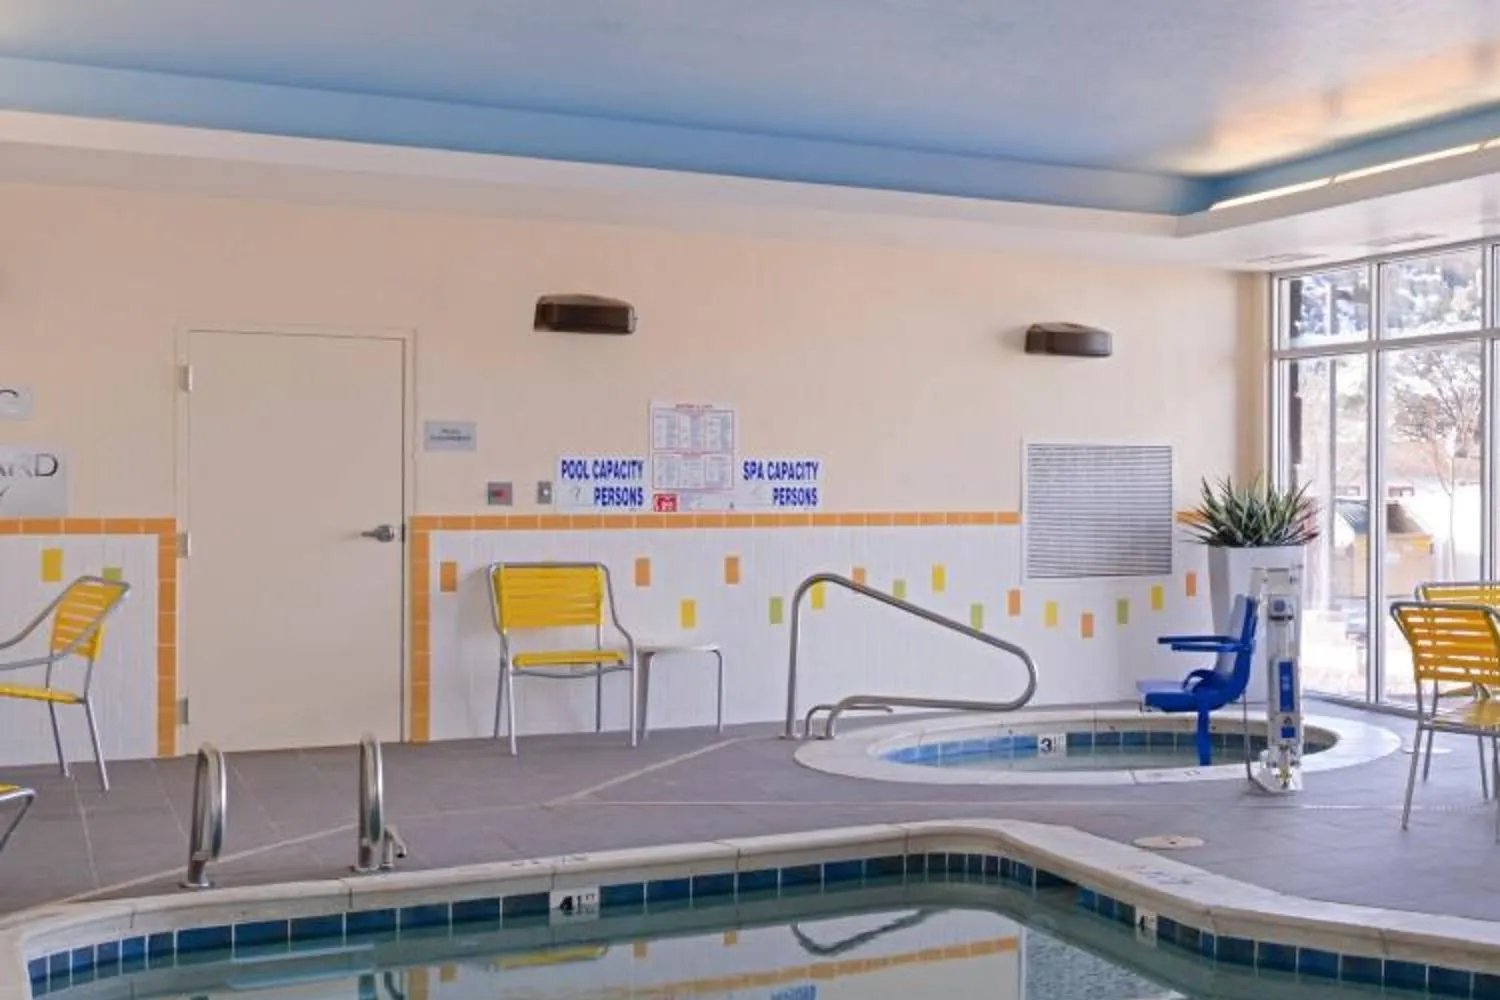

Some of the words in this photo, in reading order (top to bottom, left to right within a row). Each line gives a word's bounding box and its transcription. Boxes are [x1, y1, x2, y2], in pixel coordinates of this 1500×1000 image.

[561, 459, 591, 480] POOL
[592, 459, 644, 480] CAPACITY
[743, 460, 764, 480] SPA
[767, 460, 819, 480] CAPACITY
[593, 486, 643, 507] PERSONS
[772, 486, 818, 507] PERSONS
